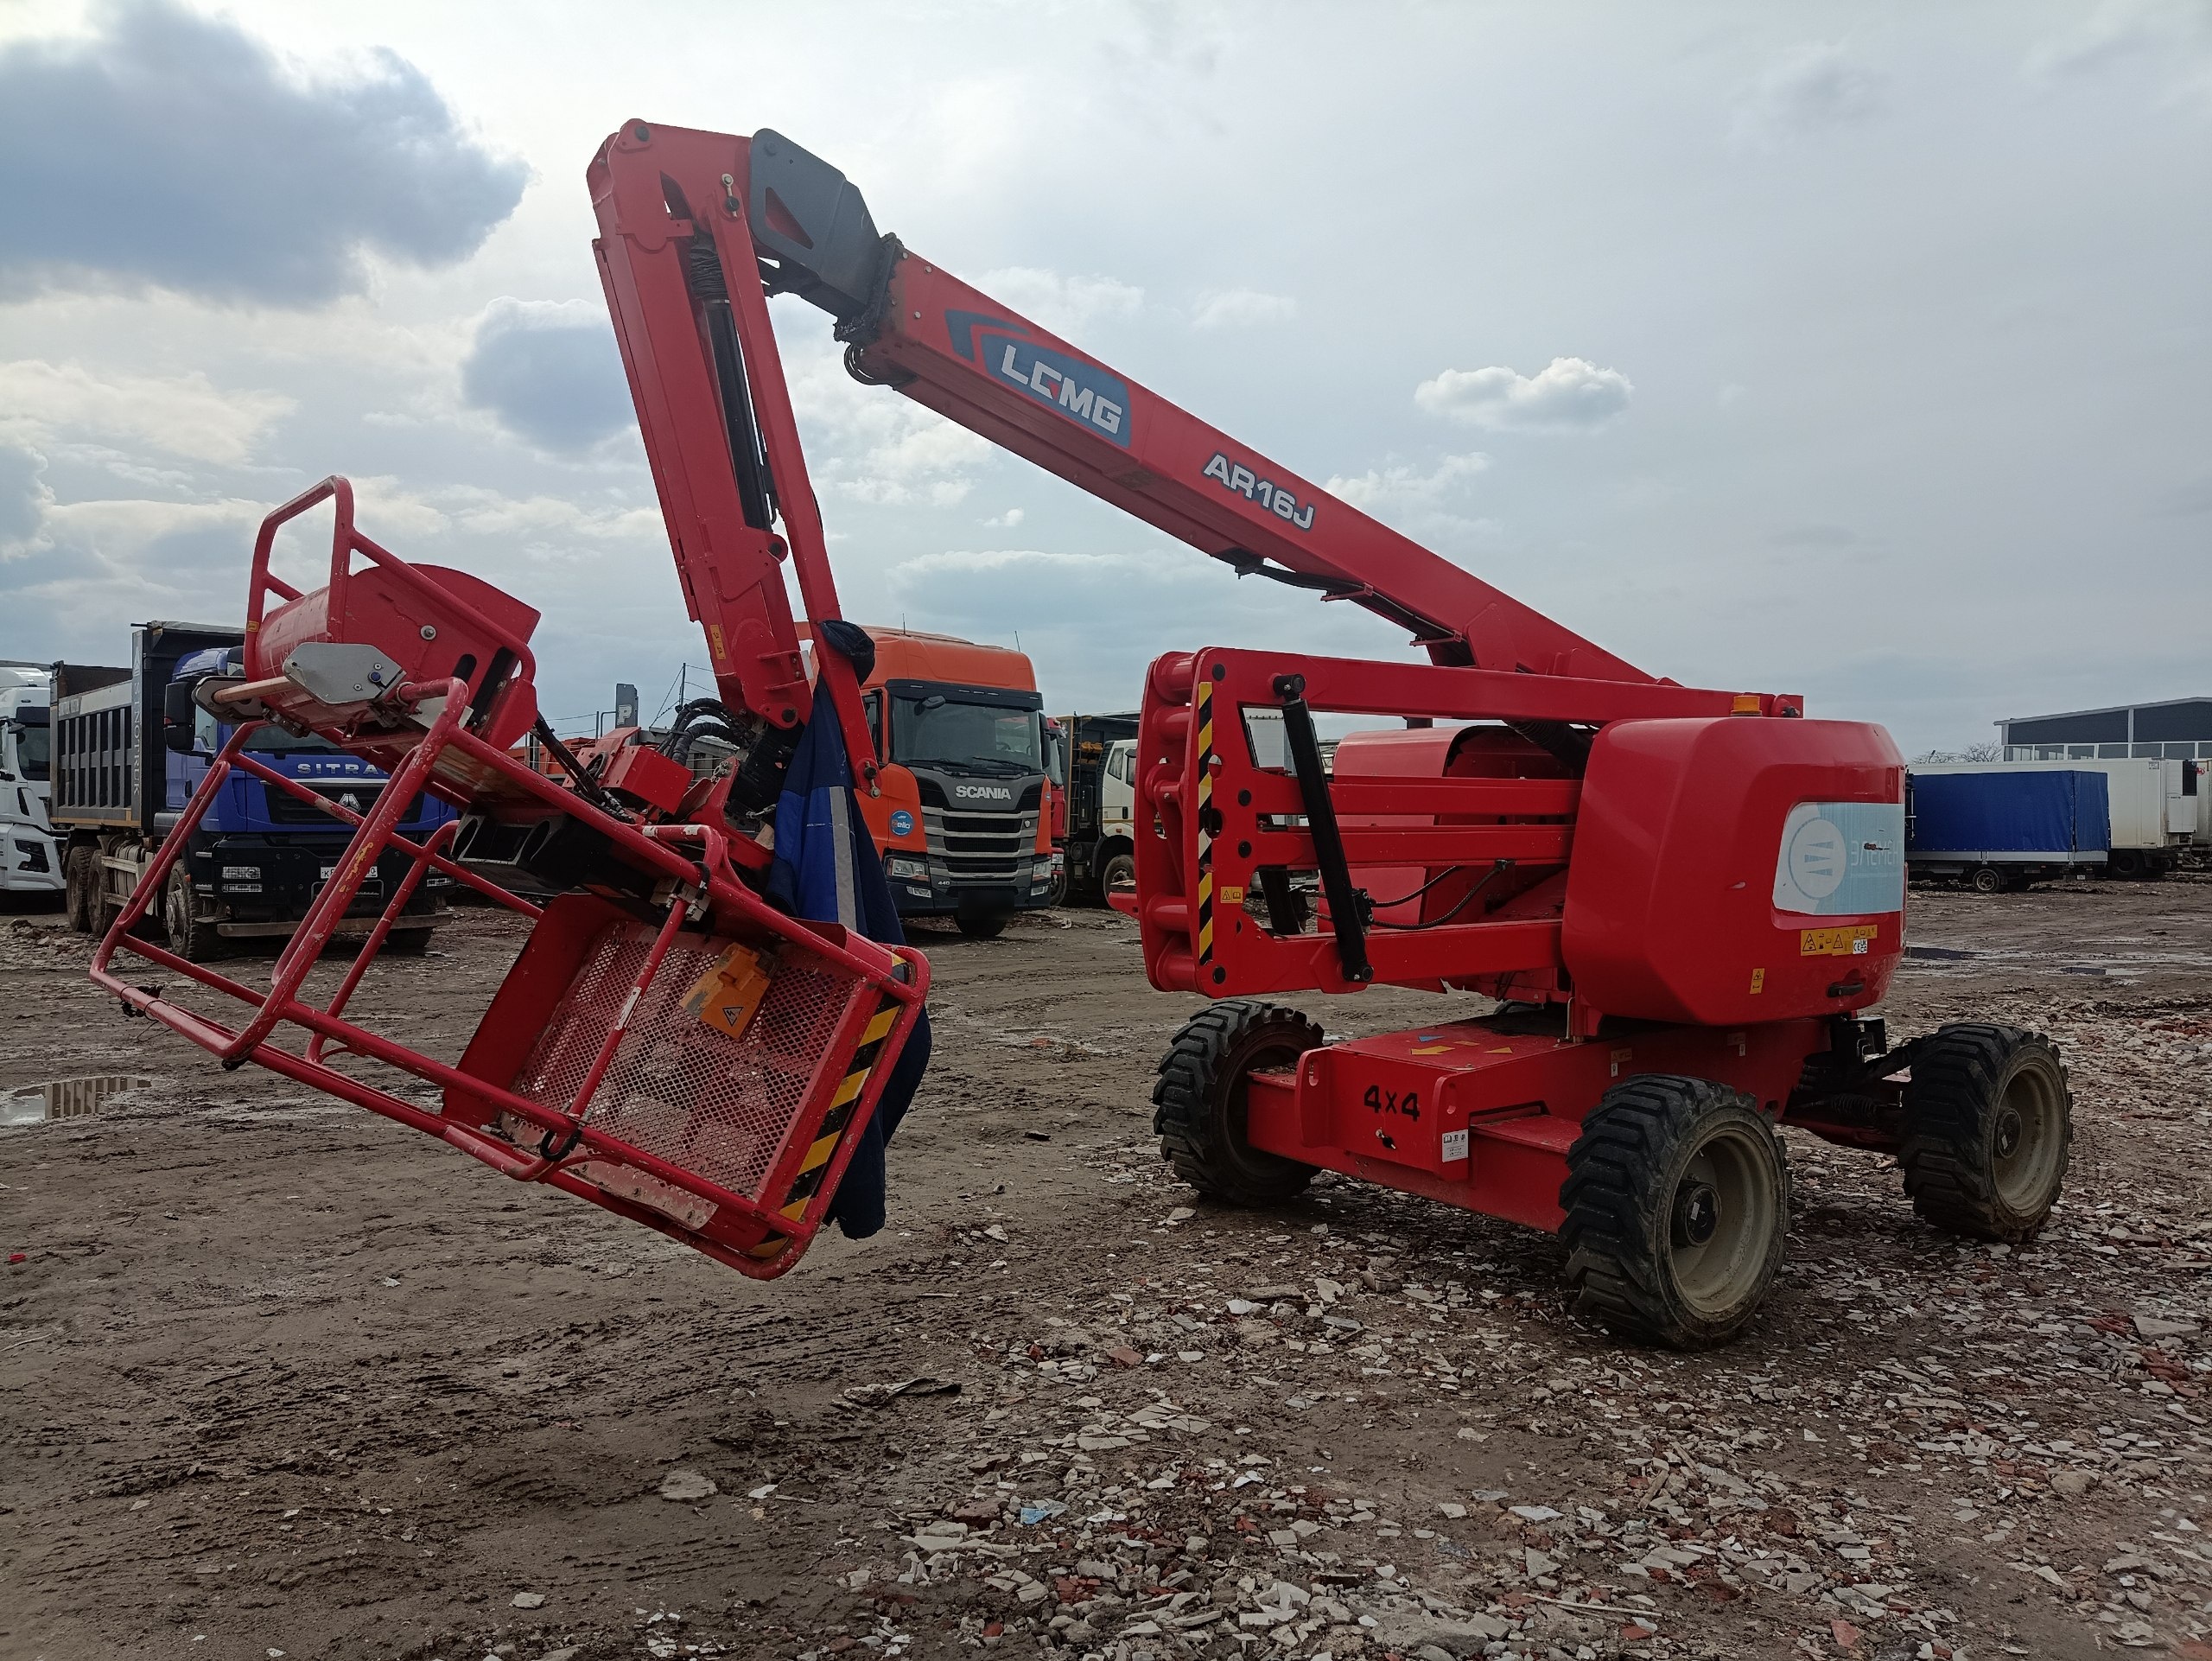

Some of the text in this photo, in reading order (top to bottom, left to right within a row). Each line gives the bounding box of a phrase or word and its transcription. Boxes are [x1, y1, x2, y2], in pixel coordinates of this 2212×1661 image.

[1001, 344, 1122, 434] LCMG
[1203, 454, 1314, 529] AR16J
[133, 682, 142, 796] SINOTRUK
[296, 763, 389, 775] SITRA
[955, 785, 1012, 800] SCANIA
